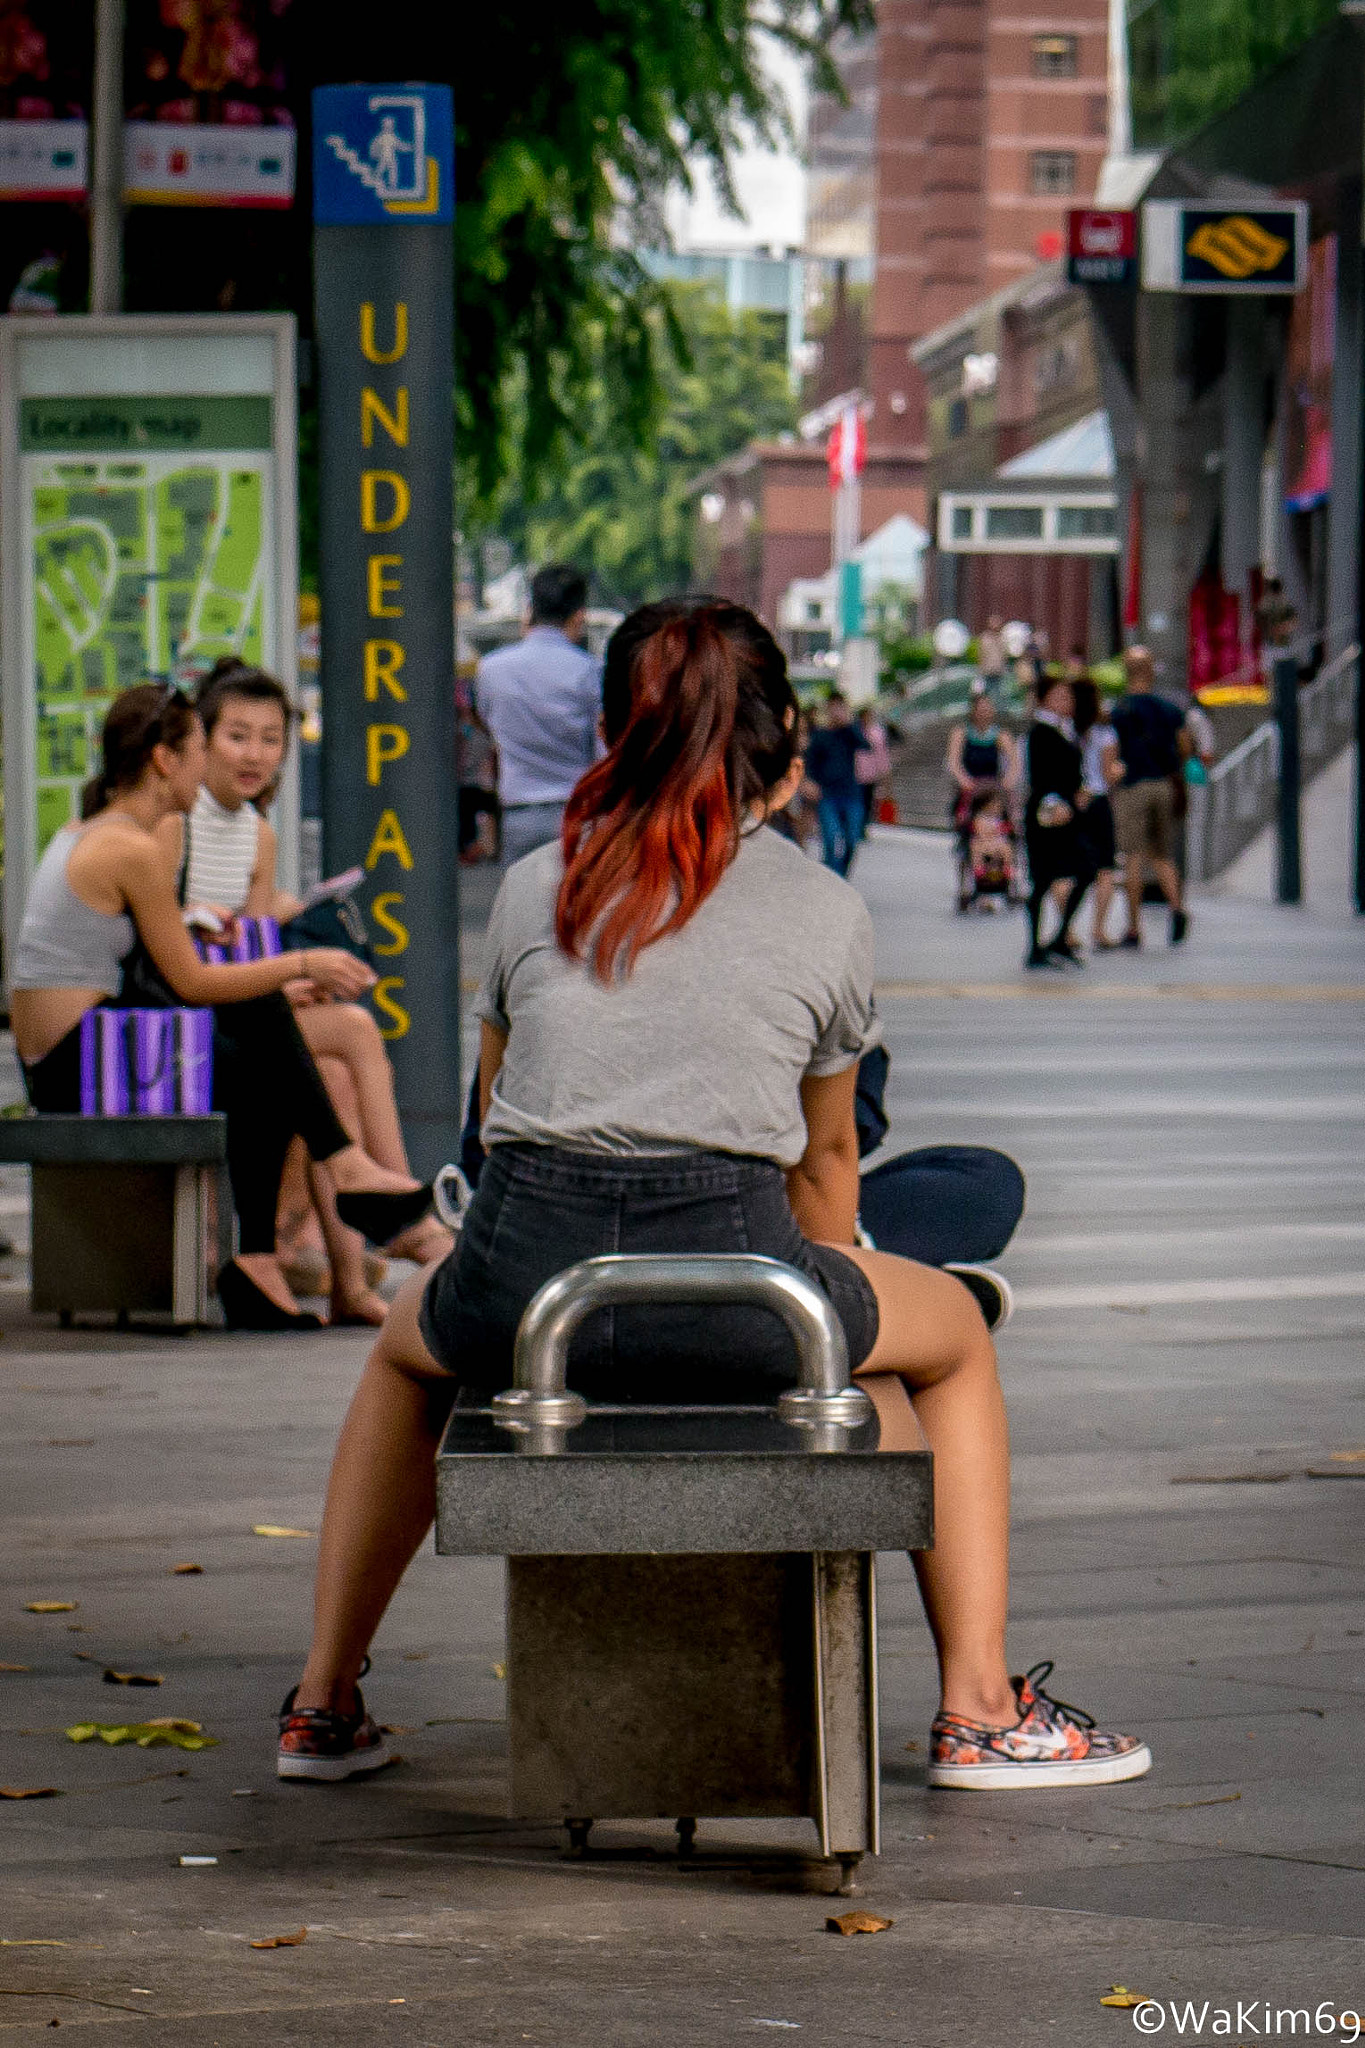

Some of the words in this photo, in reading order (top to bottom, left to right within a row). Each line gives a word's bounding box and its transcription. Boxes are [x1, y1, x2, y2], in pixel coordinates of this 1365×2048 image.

[29, 411, 130, 443] Locality
[138, 416, 202, 443] map
[359, 303, 414, 1039] UNDERPASS
